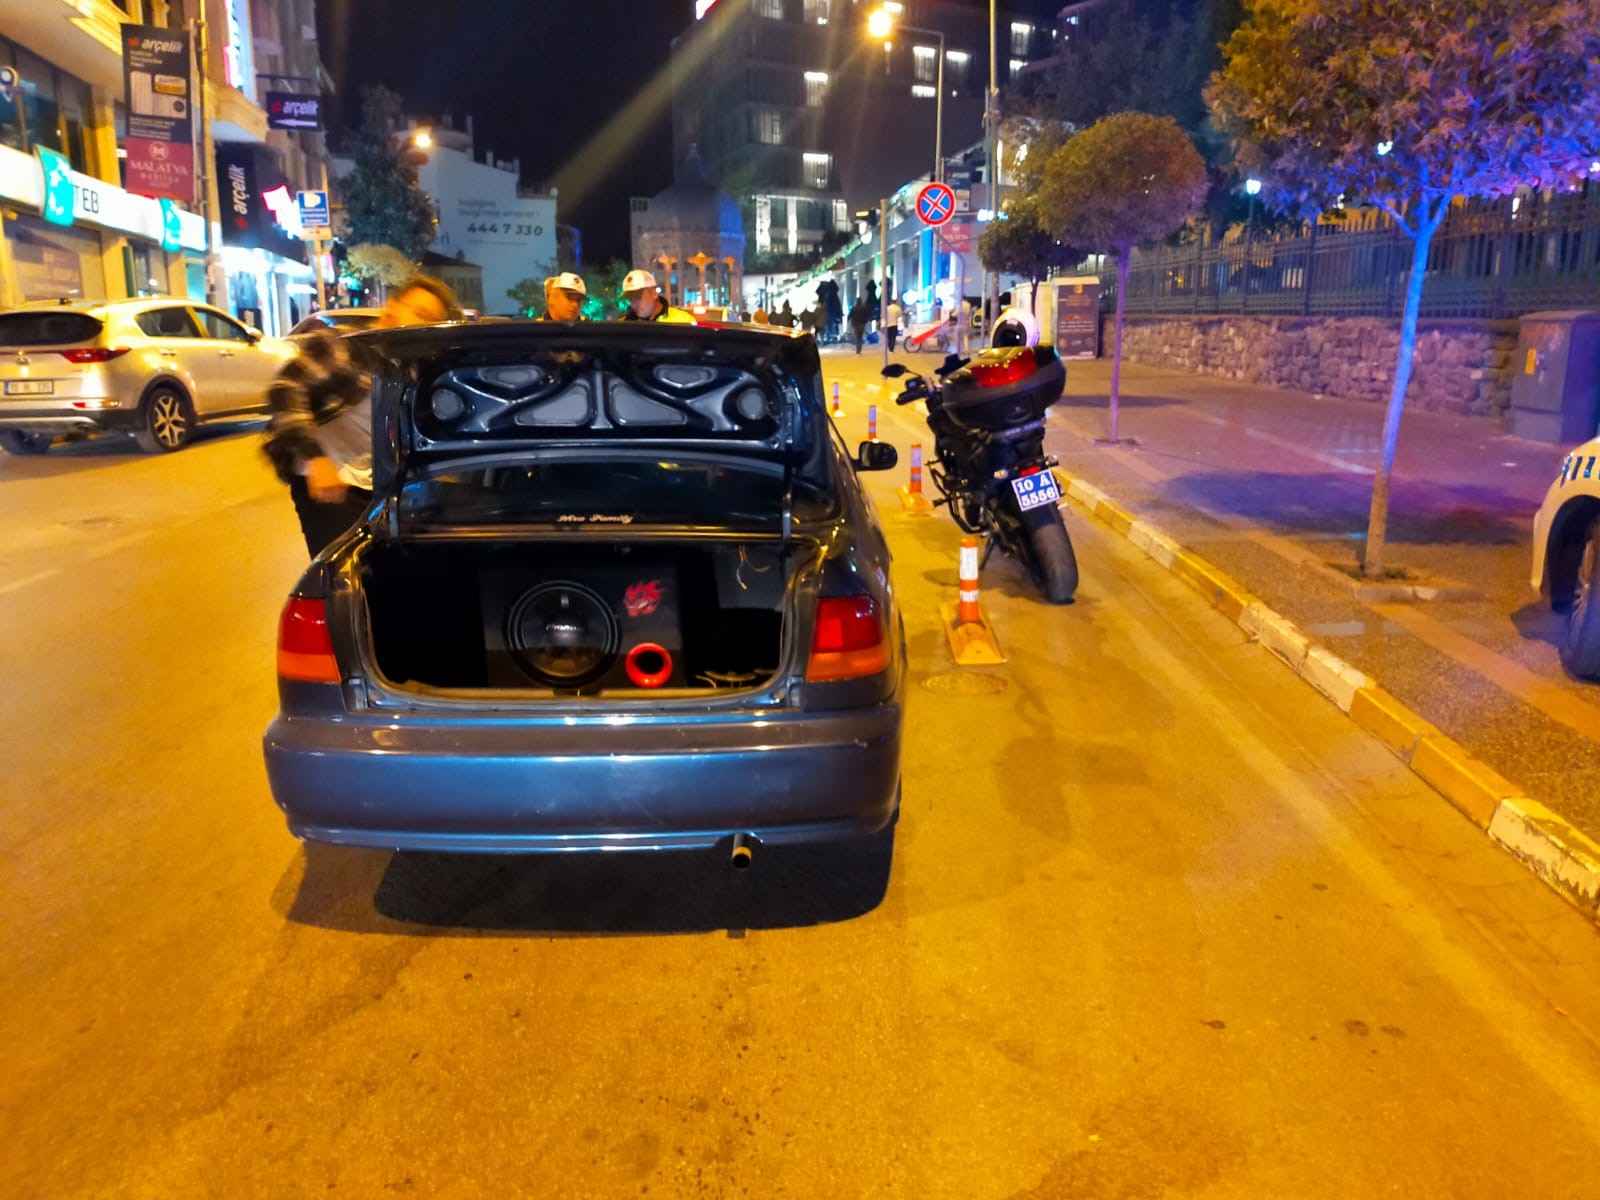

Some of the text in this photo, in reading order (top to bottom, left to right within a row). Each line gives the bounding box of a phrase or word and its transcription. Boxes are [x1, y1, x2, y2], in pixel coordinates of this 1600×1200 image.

[141, 38, 183, 54] arçelik
[283, 100, 318, 117] arçelik
[130, 160, 188, 176] MALATYA
[228, 164, 249, 214] arçelik
[73, 185, 99, 214] TEB
[466, 222, 543, 236] 444 7 330
[1017, 474, 1050, 493] 10 A
